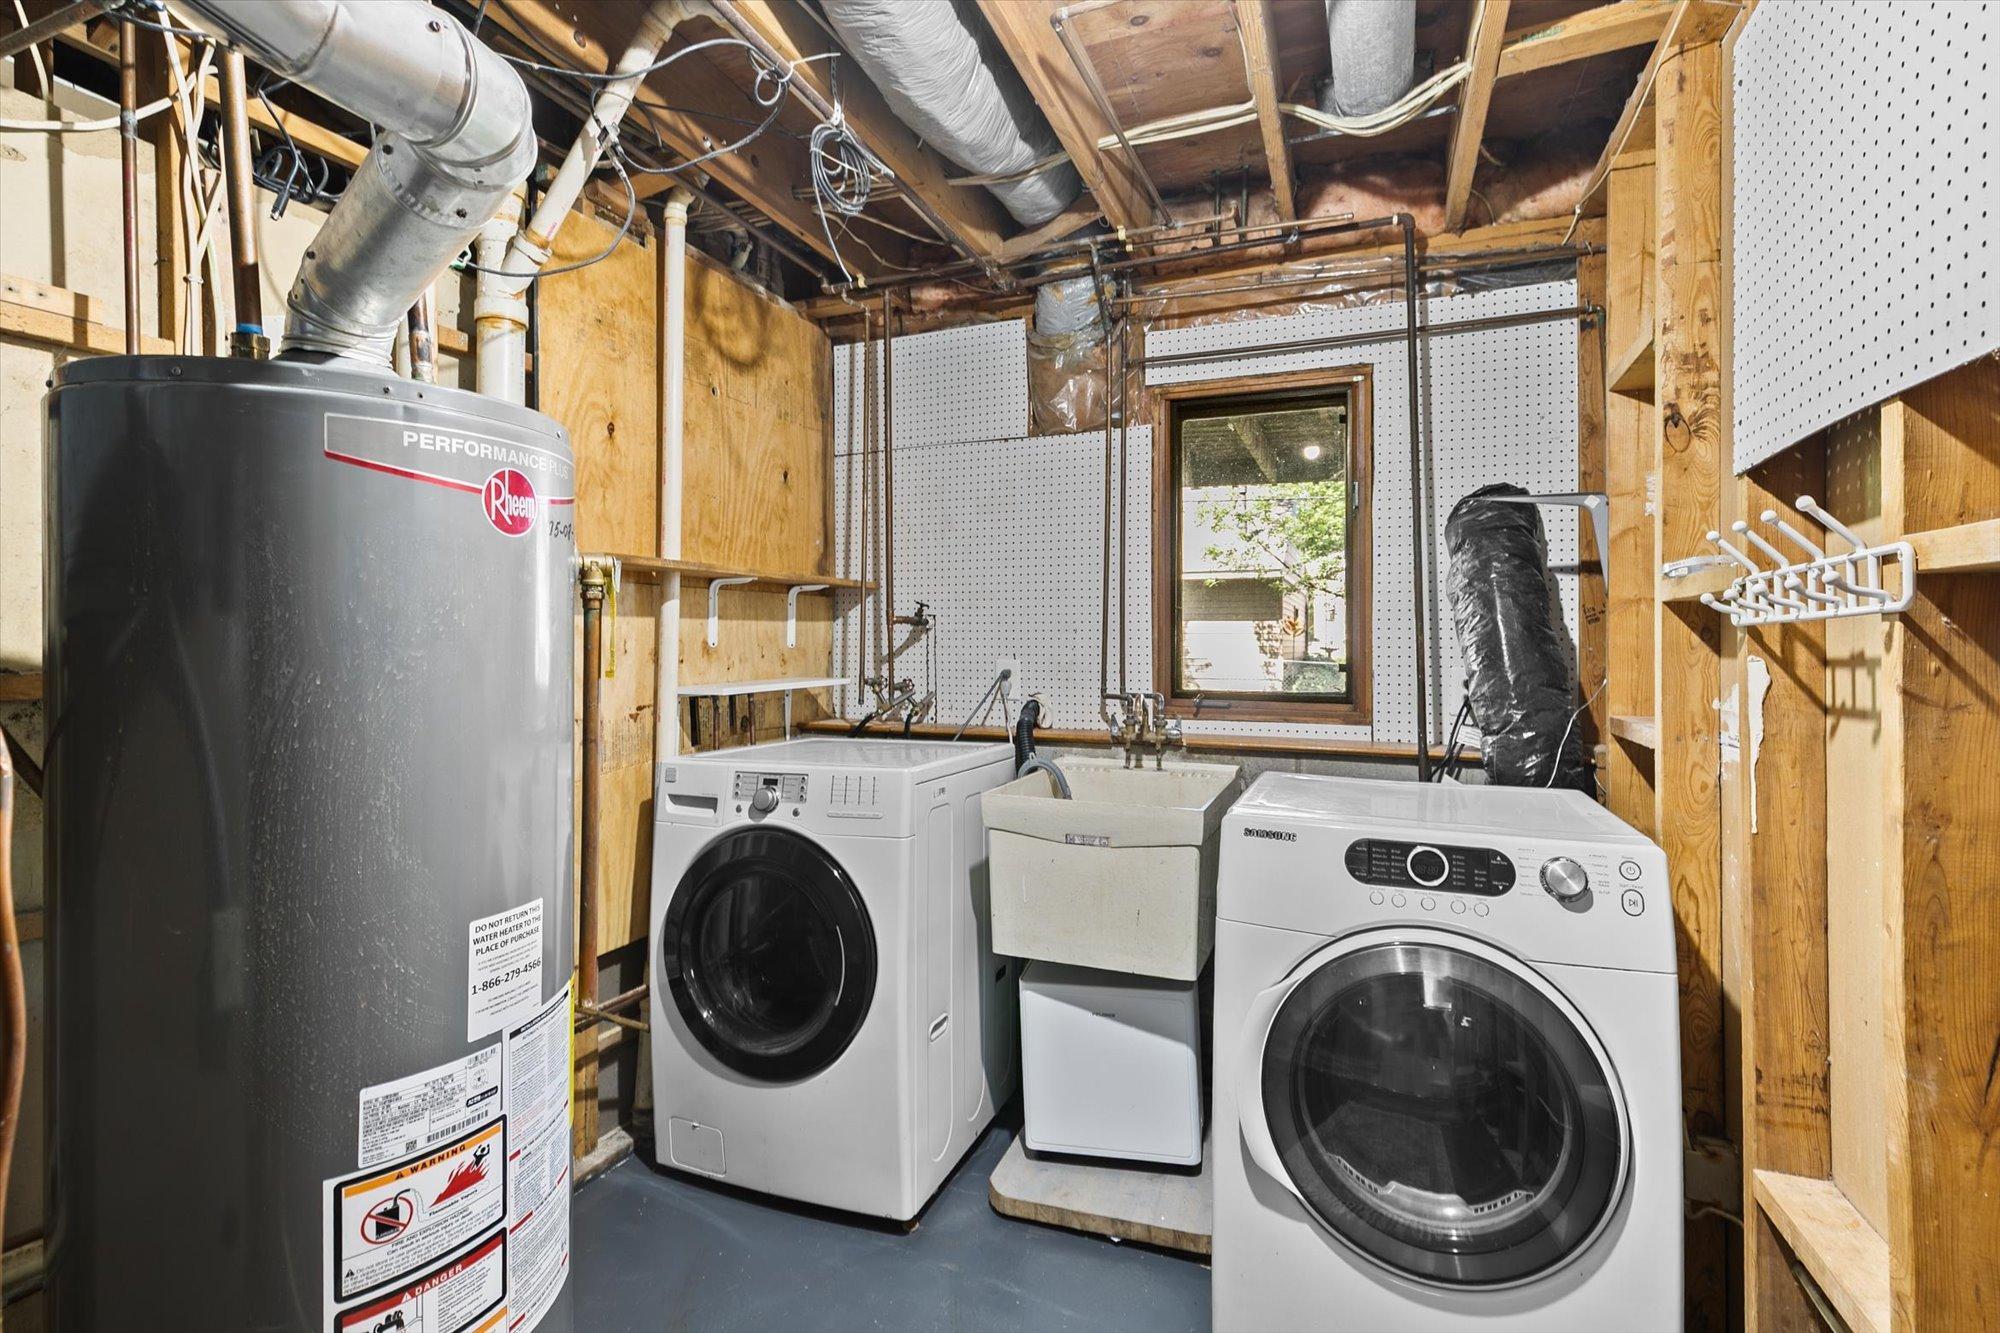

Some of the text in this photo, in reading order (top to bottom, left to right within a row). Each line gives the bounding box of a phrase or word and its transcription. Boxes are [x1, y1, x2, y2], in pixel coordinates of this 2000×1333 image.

[403, 430, 569, 480] PERFORMANCE PLUS
[491, 469, 535, 526] Rheem
[1243, 827, 1297, 842] SAMSUNG
[472, 931, 498, 945] WATER
[499, 922, 523, 937] HEATER
[524, 919, 531, 928] TO
[475, 924, 487, 933] DO
[489, 919, 503, 930] NOT
[504, 910, 528, 924] RETURN
[475, 926, 539, 956] PLACE OF PURCHASE
[471, 957, 541, 996] 1-866-279-4566
[410, 1144, 466, 1174] WARNING
[415, 1264, 463, 1296] DANGER
